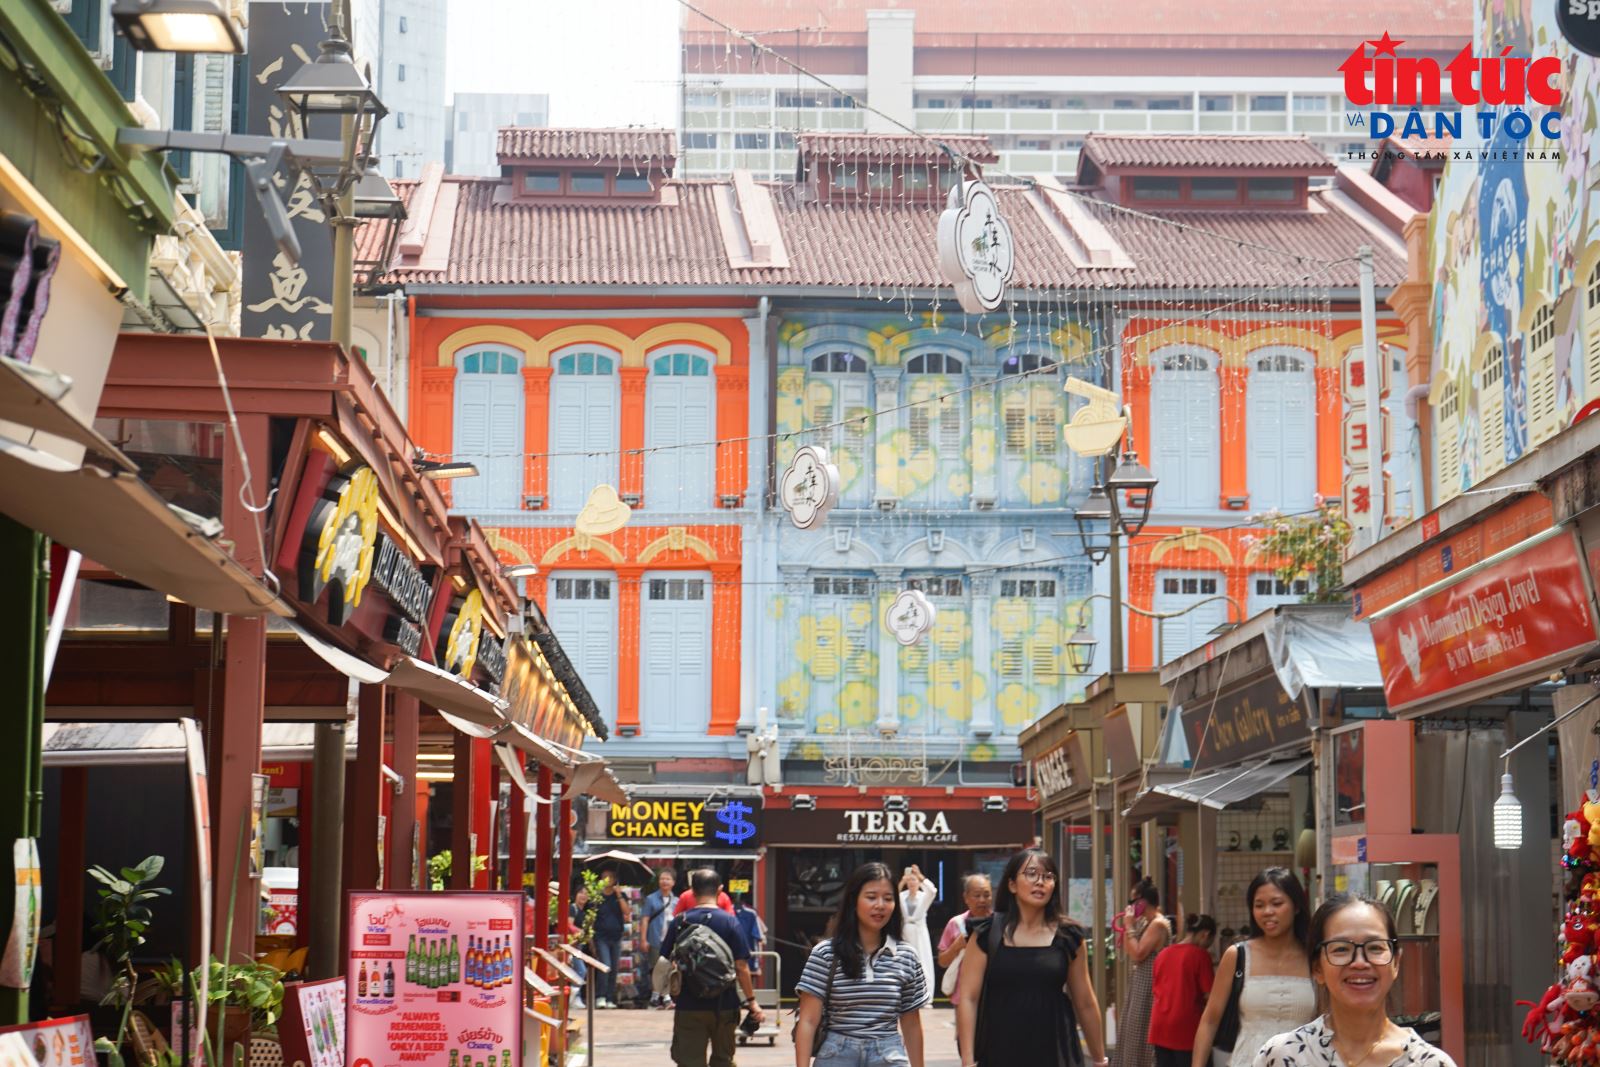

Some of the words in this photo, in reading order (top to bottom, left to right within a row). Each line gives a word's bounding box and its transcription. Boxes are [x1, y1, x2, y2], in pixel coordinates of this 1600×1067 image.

[1483, 219, 1526, 279] CHAGEE
[1468, 587, 1508, 628] Design
[1505, 567, 1541, 613] Jewel
[1510, 624, 1527, 648] Ltd
[824, 756, 928, 782] SHOPS
[611, 801, 704, 821] MONEY
[611, 822, 704, 837] CHANGE
[844, 810, 952, 834] TERRA
[837, 833, 896, 842] RESTAURANT
[906, 833, 924, 842] BAR
[934, 834, 957, 842] CAFE
[480, 993, 496, 1001] Tiger
[387, 1032, 438, 1041] HAPPINESS
[438, 1032, 448, 1041] IS
[390, 1042, 414, 1051] ONLY
[415, 1042, 422, 1051] A
[423, 1042, 445, 1051] BEER
[467, 1041, 494, 1051] Chang
